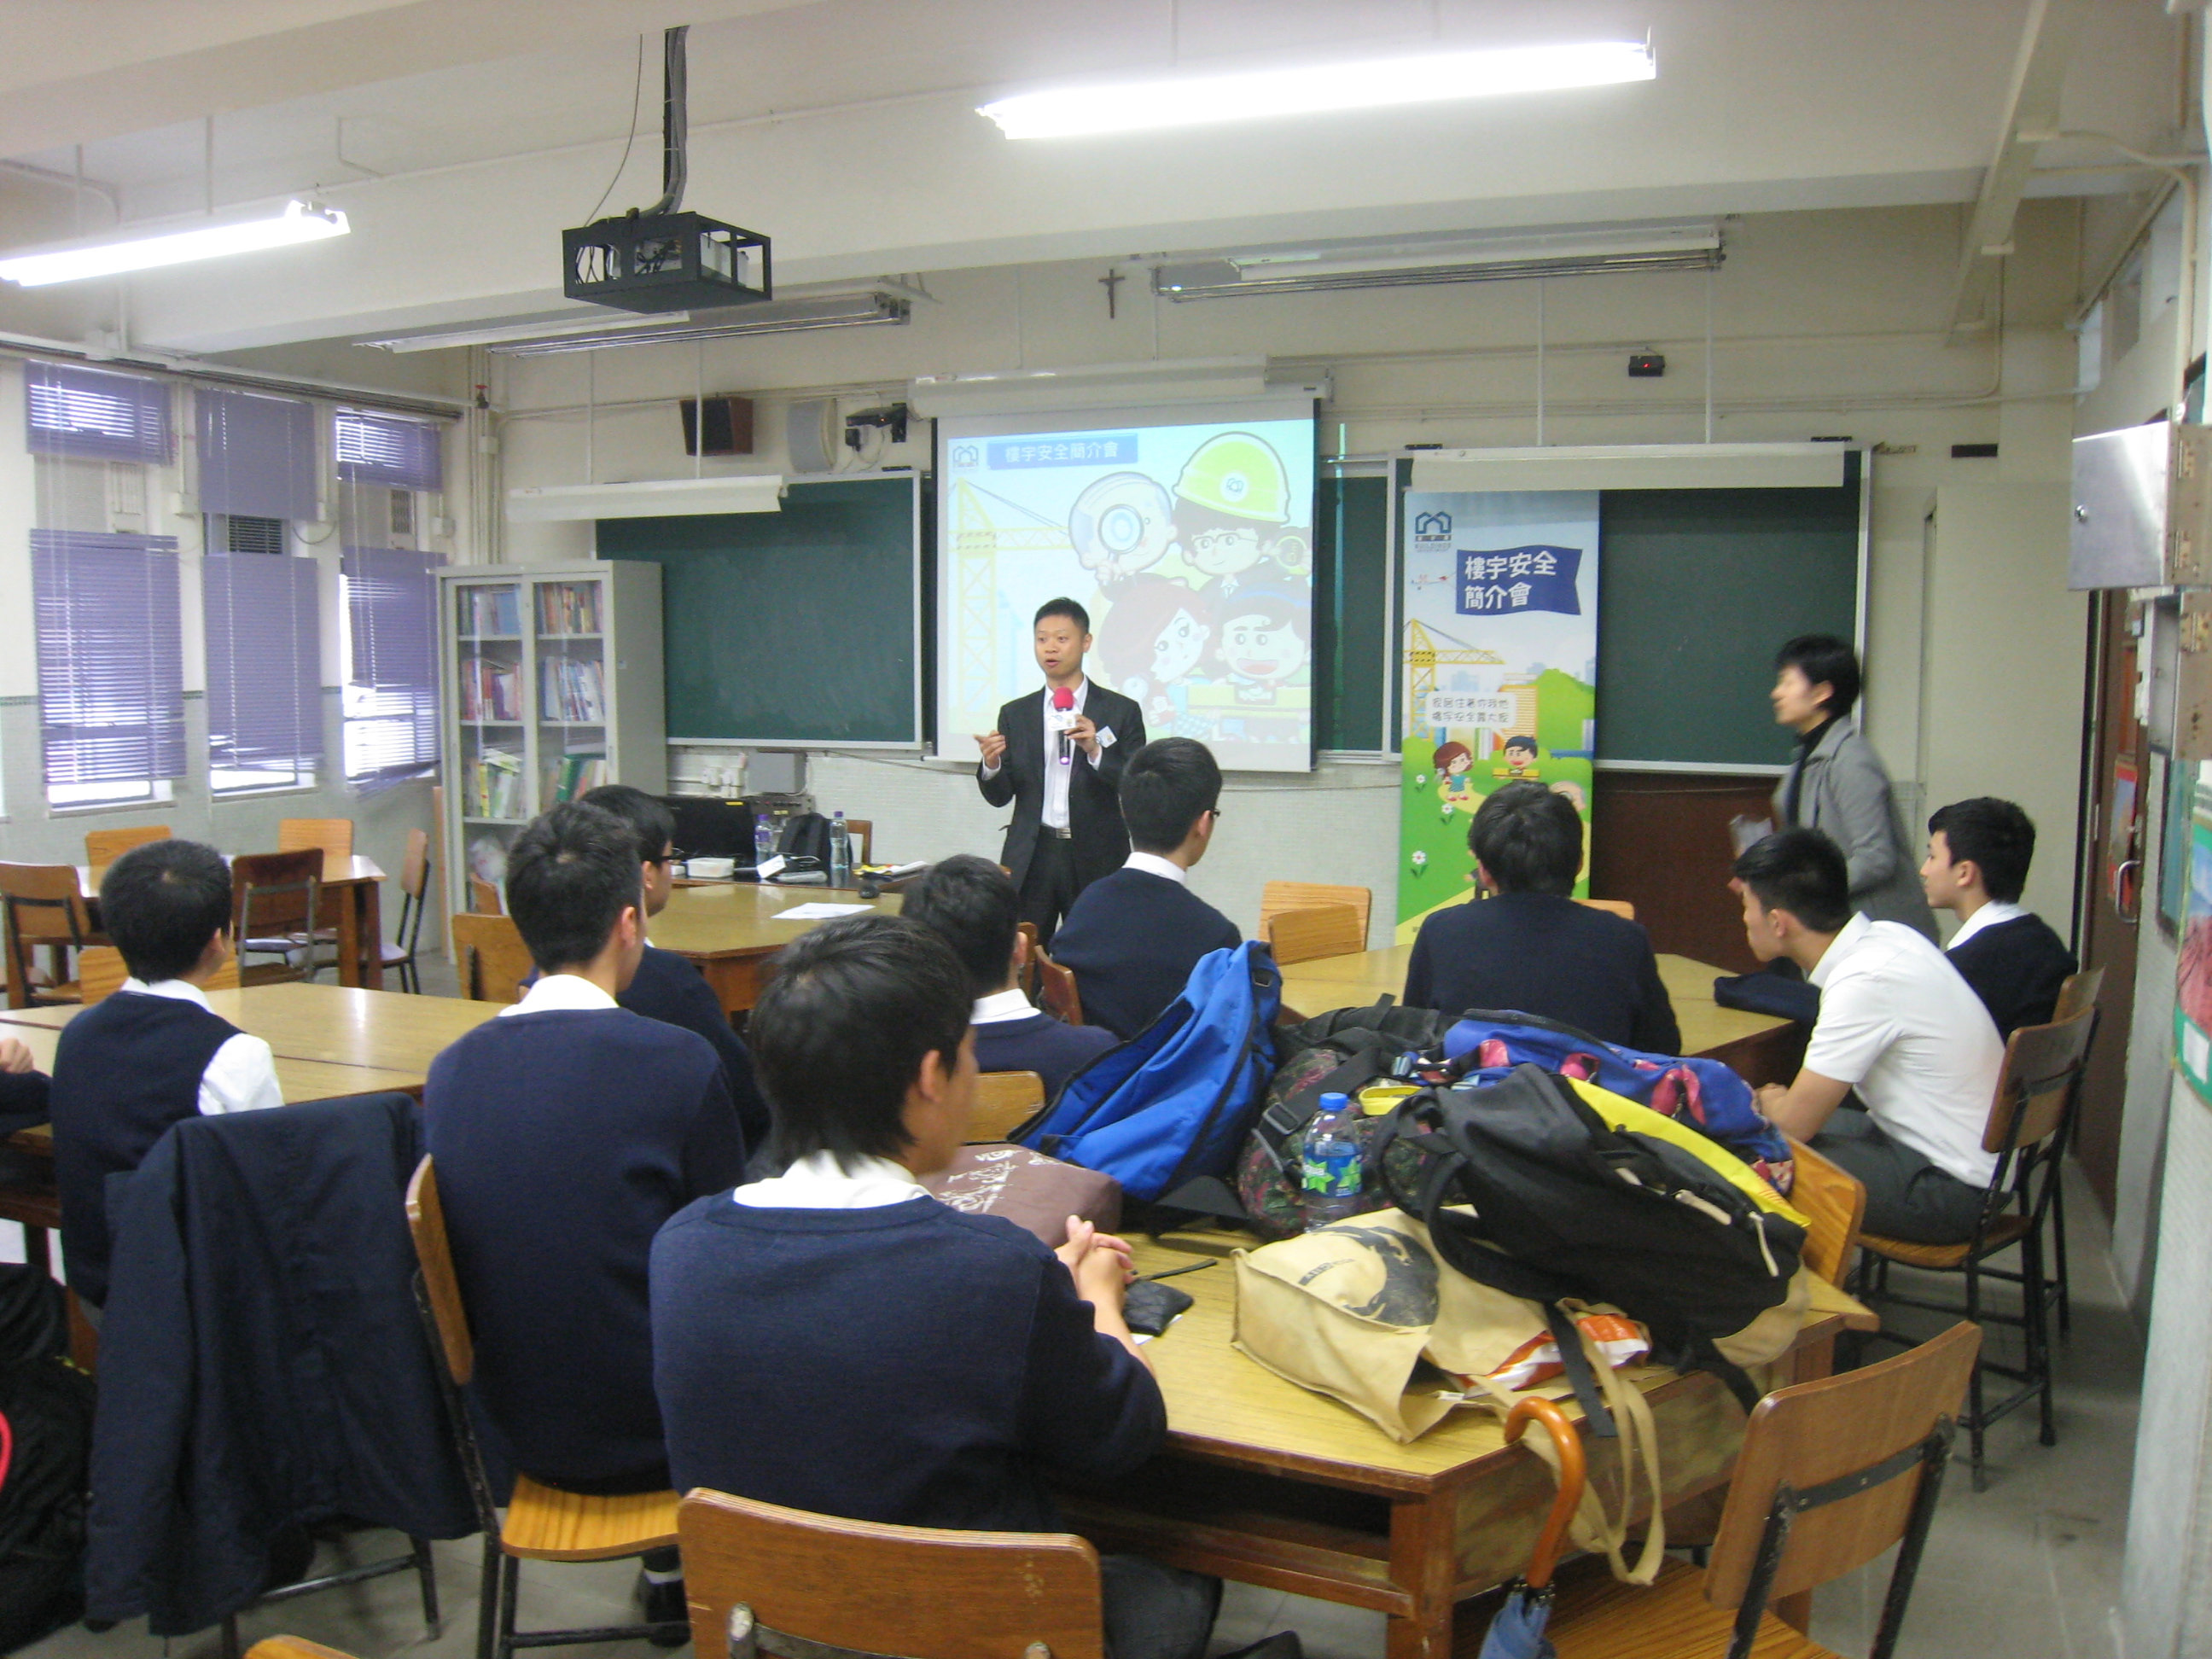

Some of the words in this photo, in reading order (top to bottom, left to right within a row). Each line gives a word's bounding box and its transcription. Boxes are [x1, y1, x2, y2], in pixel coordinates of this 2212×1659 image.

[1005, 441, 1119, 463] 樓宇安全簡介會
[1464, 550, 1557, 580] 樓宇安全
[1464, 581, 1533, 609] 簡介會
